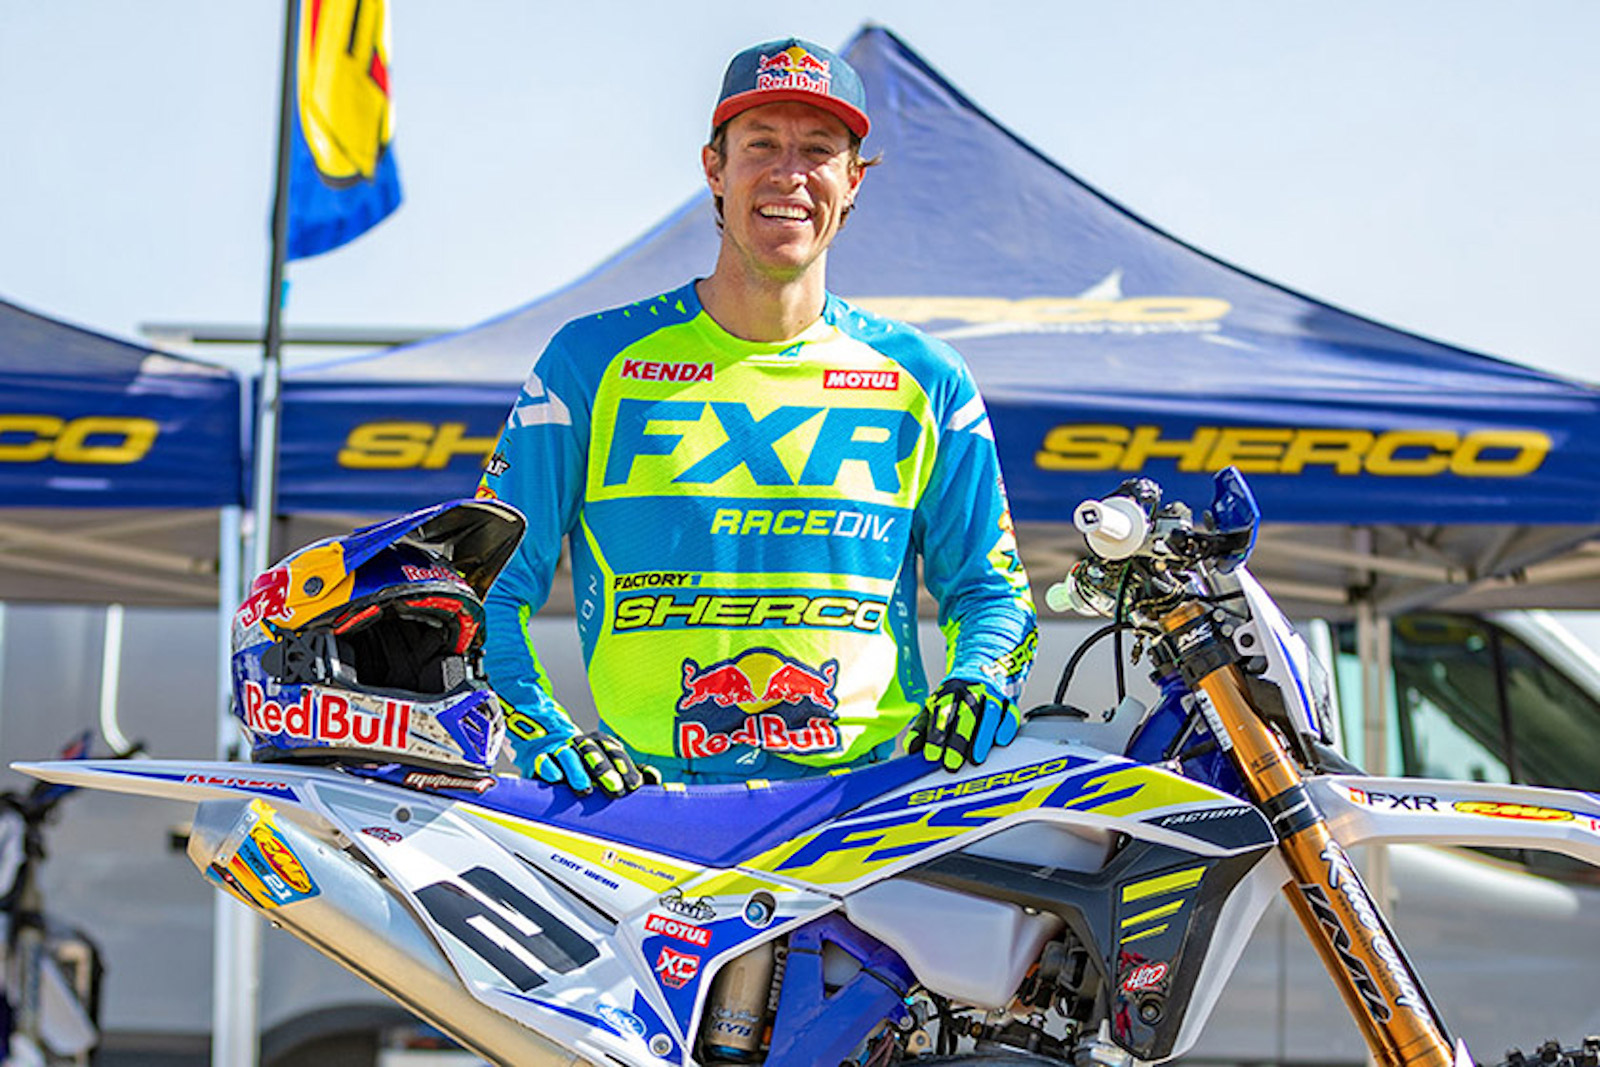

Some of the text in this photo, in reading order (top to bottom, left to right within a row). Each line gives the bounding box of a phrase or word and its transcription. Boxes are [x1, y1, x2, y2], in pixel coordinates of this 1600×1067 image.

[758, 73, 829, 94] Red Bull
[621, 359, 714, 382] KENDA
[825, 371, 898, 389] MOTUL
[602, 397, 923, 495] FXR
[1034, 424, 1553, 477] SHERCO
[613, 573, 689, 590] FACTORY
[613, 594, 889, 632] SHERCO
[245, 683, 412, 750] Red Bull
[681, 714, 837, 760] Red Bull
[907, 757, 1069, 806] SHERCO
[1367, 792, 1439, 812] FXR
[648, 916, 709, 946] MOTUL
